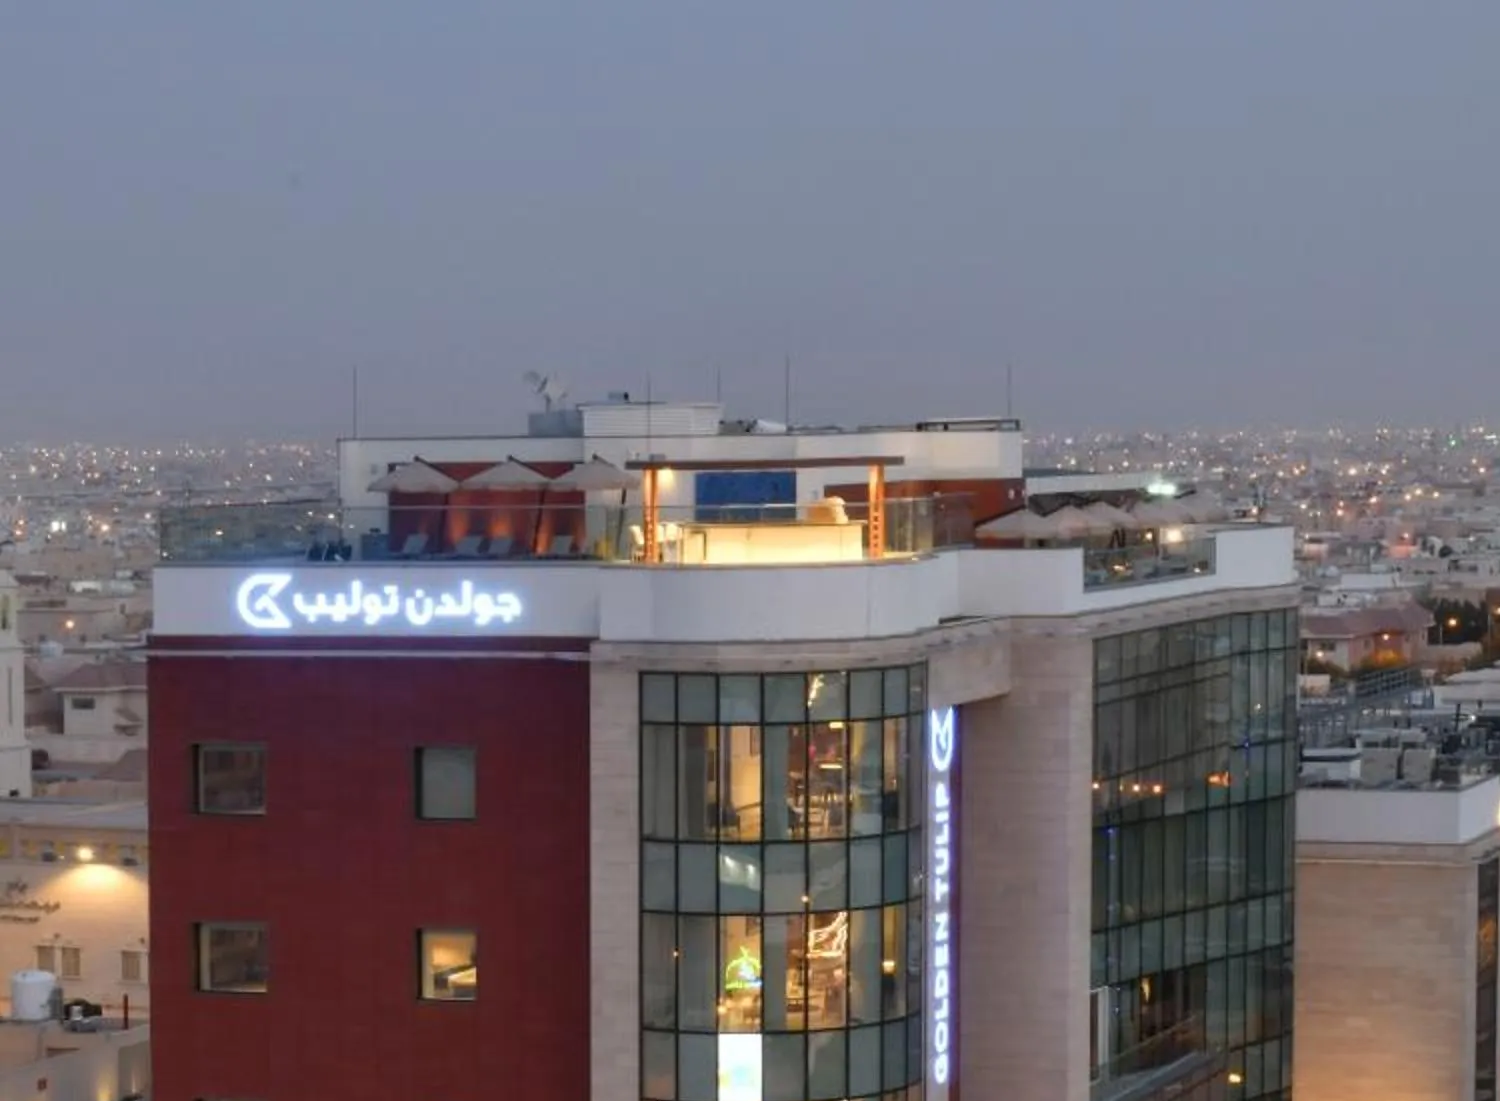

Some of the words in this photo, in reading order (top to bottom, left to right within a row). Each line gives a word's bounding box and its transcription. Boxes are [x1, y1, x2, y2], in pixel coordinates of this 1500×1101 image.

[291, 576, 401, 626] توليب
[404, 579, 523, 626] جولدن
[934, 781, 950, 902] TULIP
[934, 911, 950, 1084] GOLDEN
